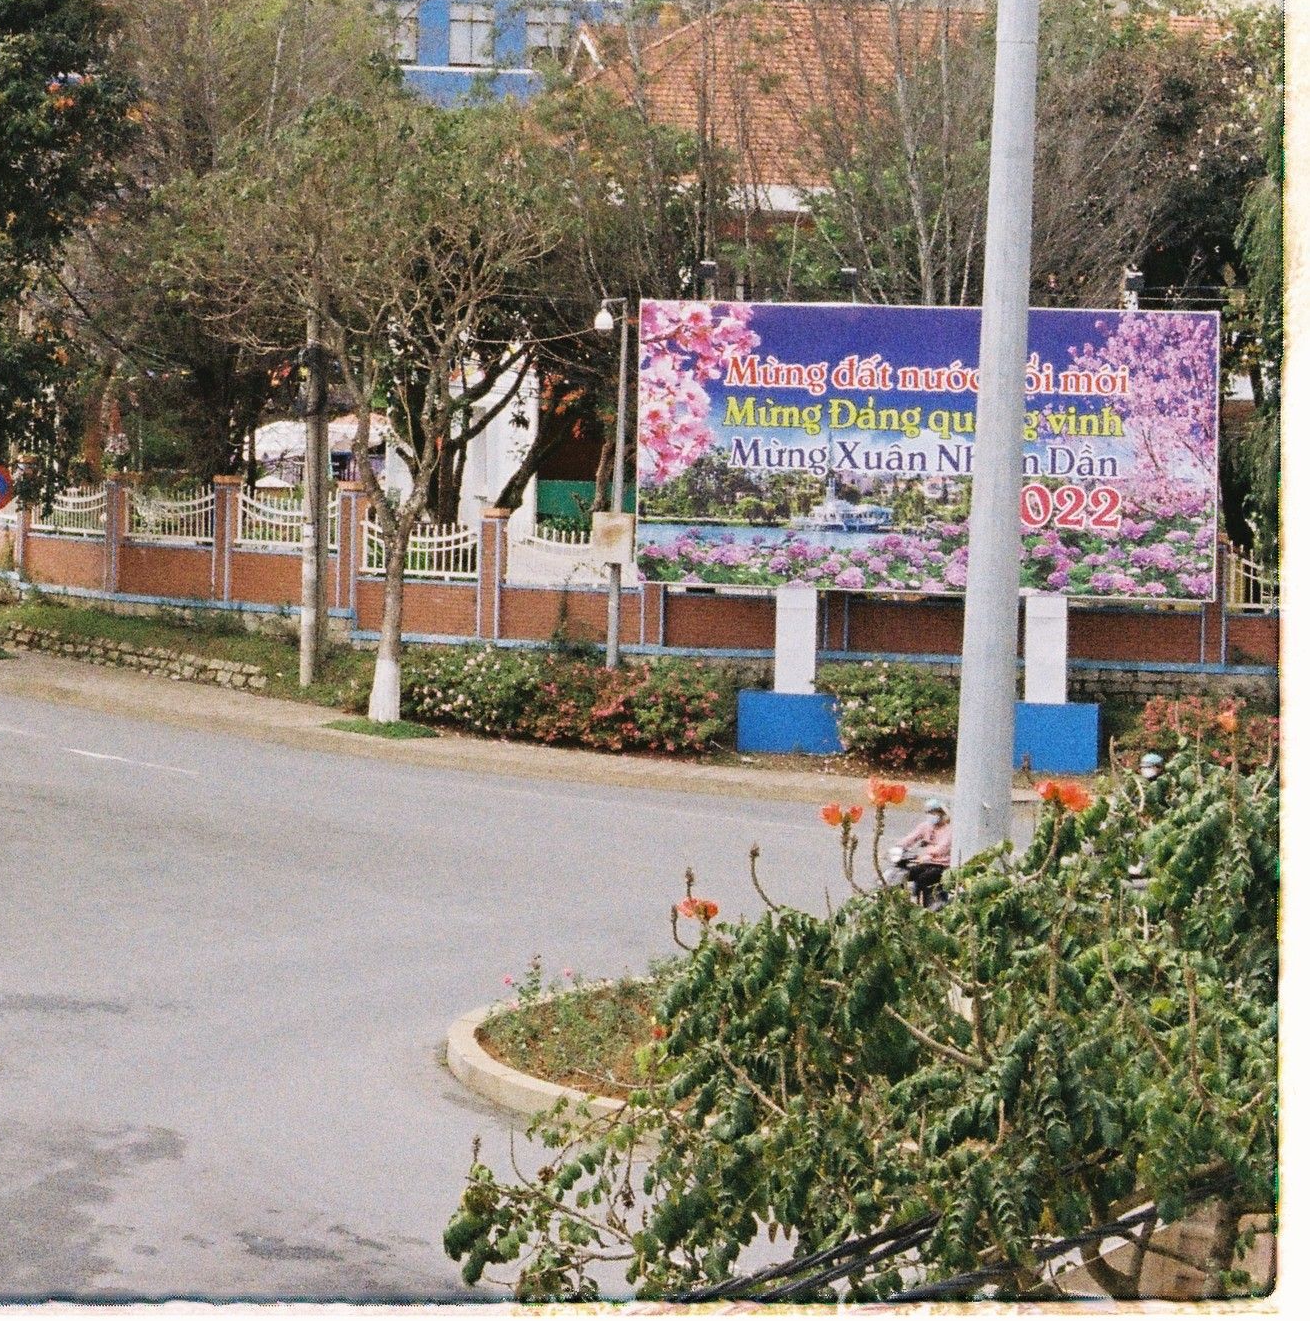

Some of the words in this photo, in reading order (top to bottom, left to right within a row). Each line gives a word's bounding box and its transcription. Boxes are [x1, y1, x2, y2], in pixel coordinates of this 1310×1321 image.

[724, 354, 828, 396] Mừng
[832, 354, 893, 390] đất
[1059, 364, 1130, 395] mới
[724, 396, 822, 435] Mừng
[829, 396, 921, 438] Đảng
[928, 409, 1040, 441] qug
[1046, 406, 1125, 437] vinh
[730, 438, 828, 476] Mừng
[836, 440, 927, 472] Xuân
[1047, 443, 1119, 477] Dần
[1019, 483, 1121, 529] 022
